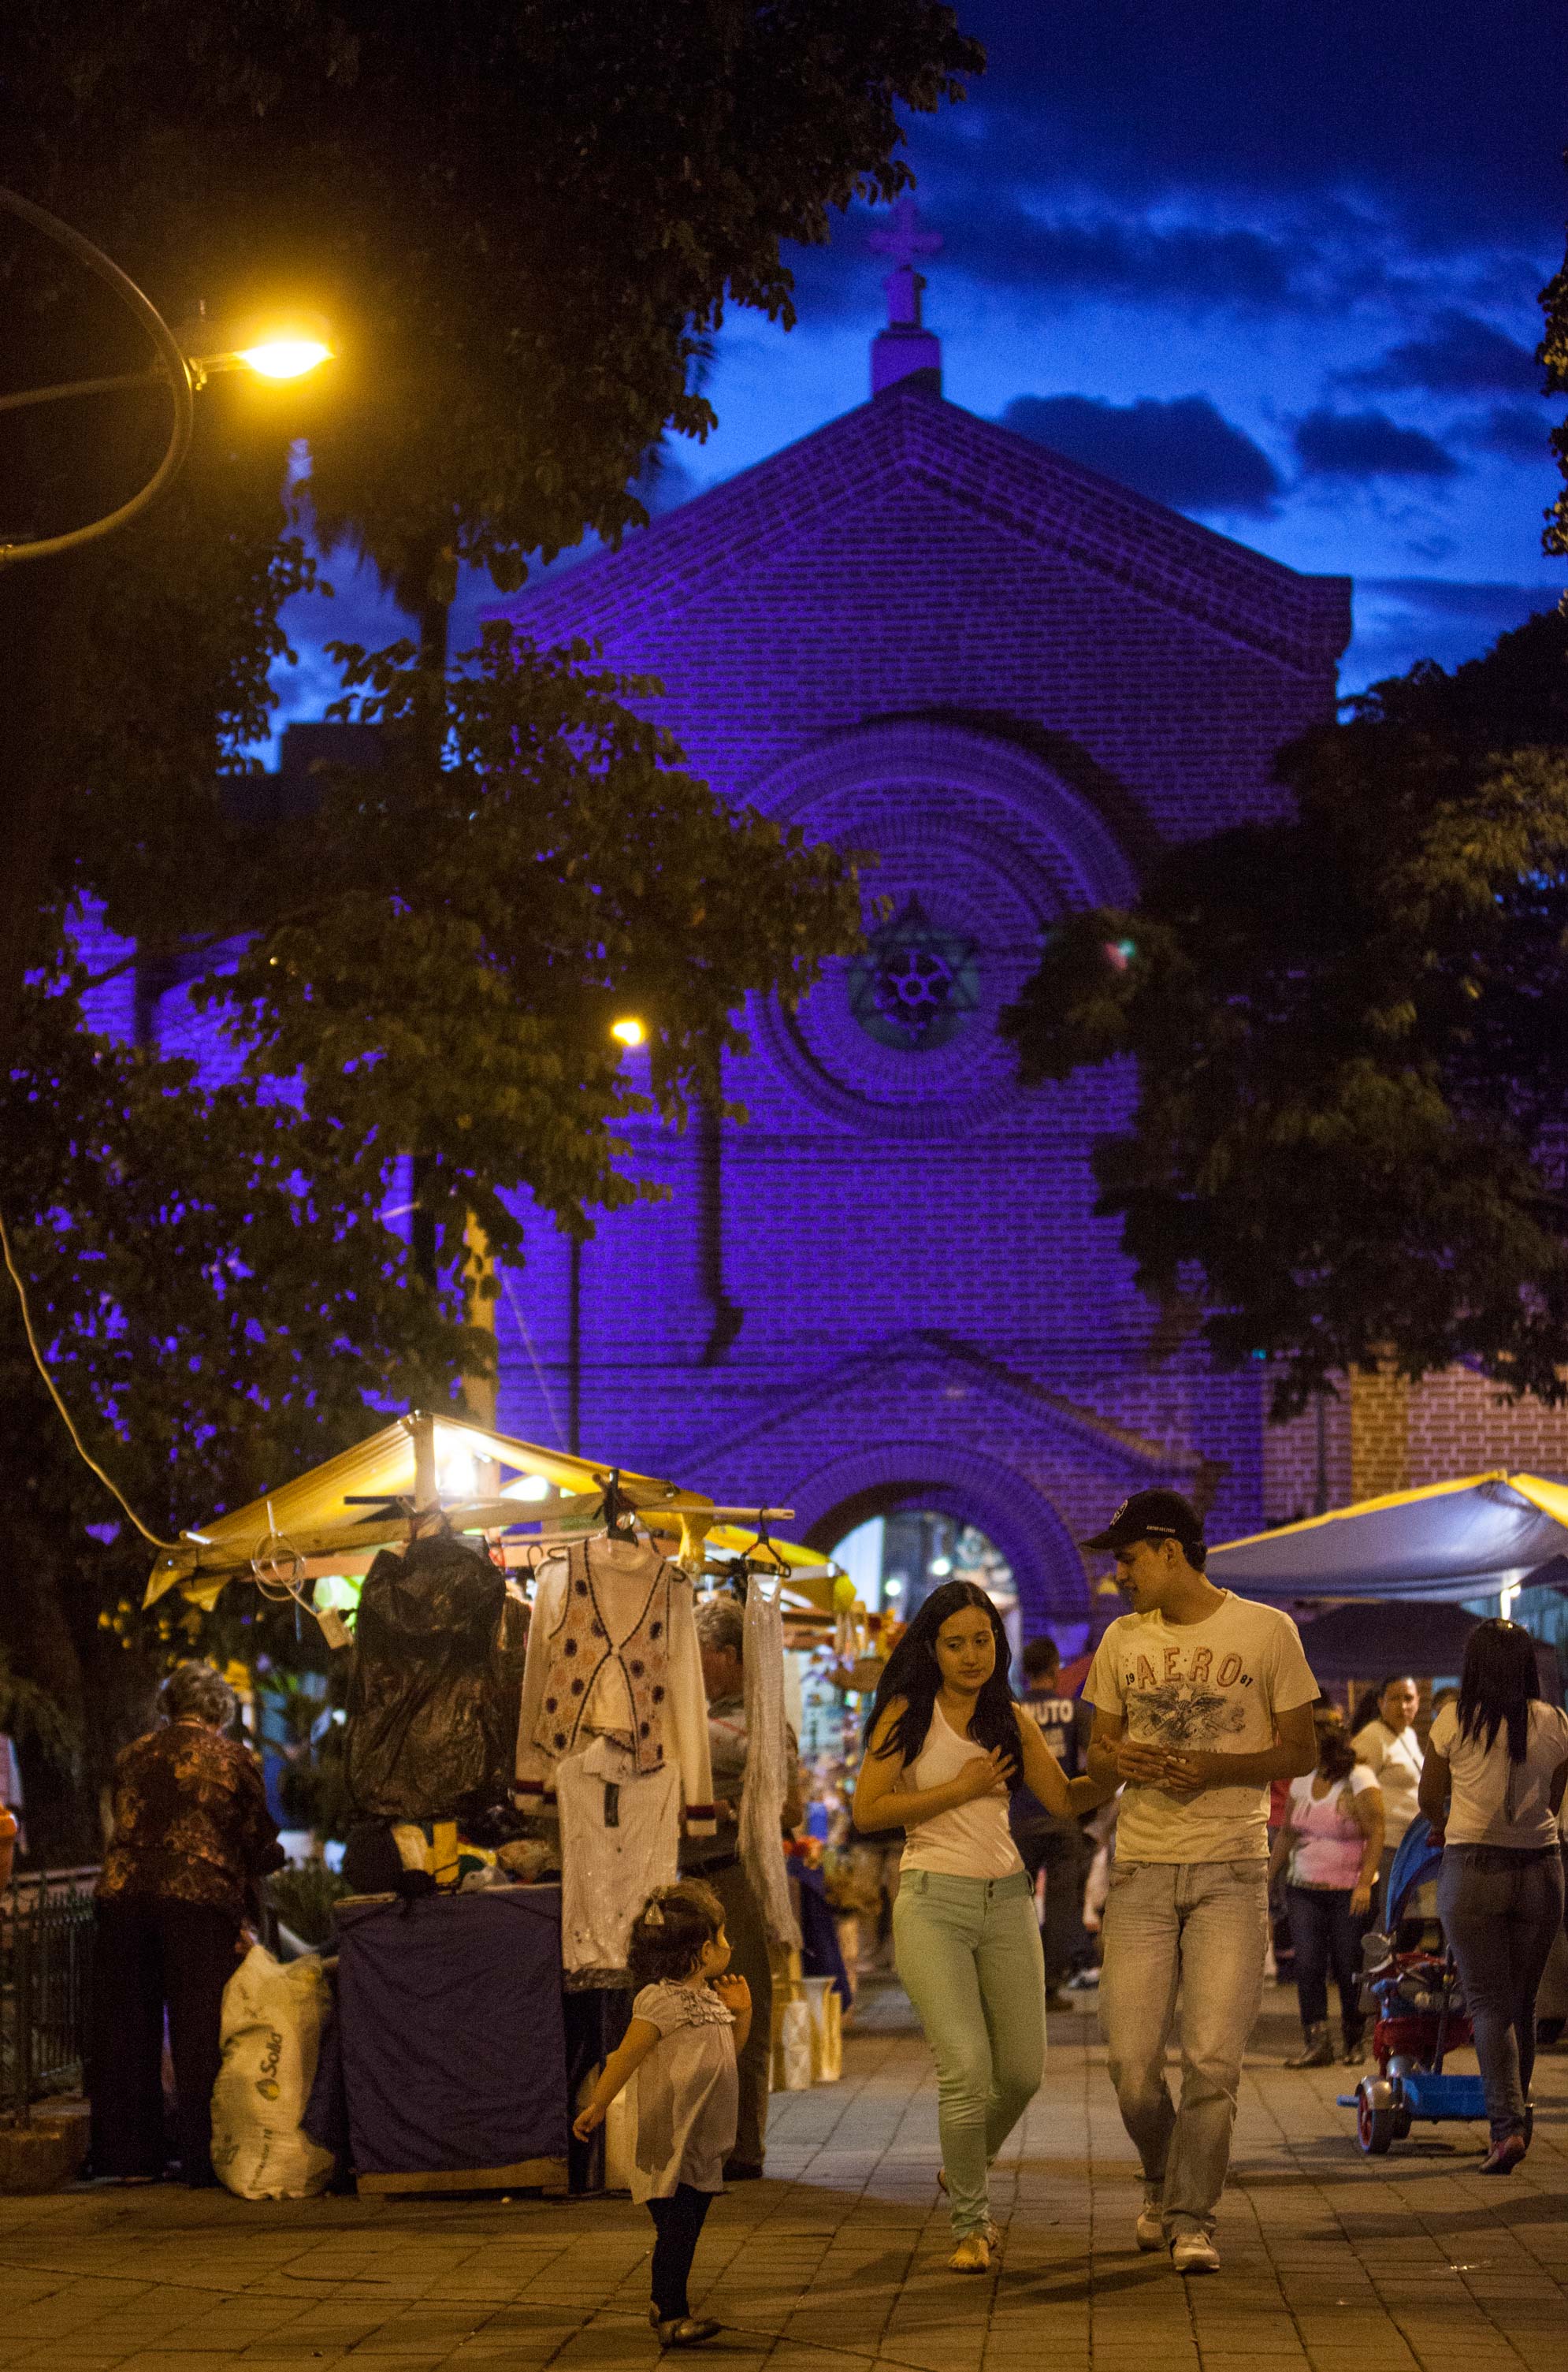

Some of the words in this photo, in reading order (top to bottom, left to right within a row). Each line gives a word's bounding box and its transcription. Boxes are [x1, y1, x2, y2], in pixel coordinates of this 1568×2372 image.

[1126, 1672, 1135, 1686] 19
[1136, 1646, 1243, 1690] AERO
[1239, 1675, 1254, 1687] 87
